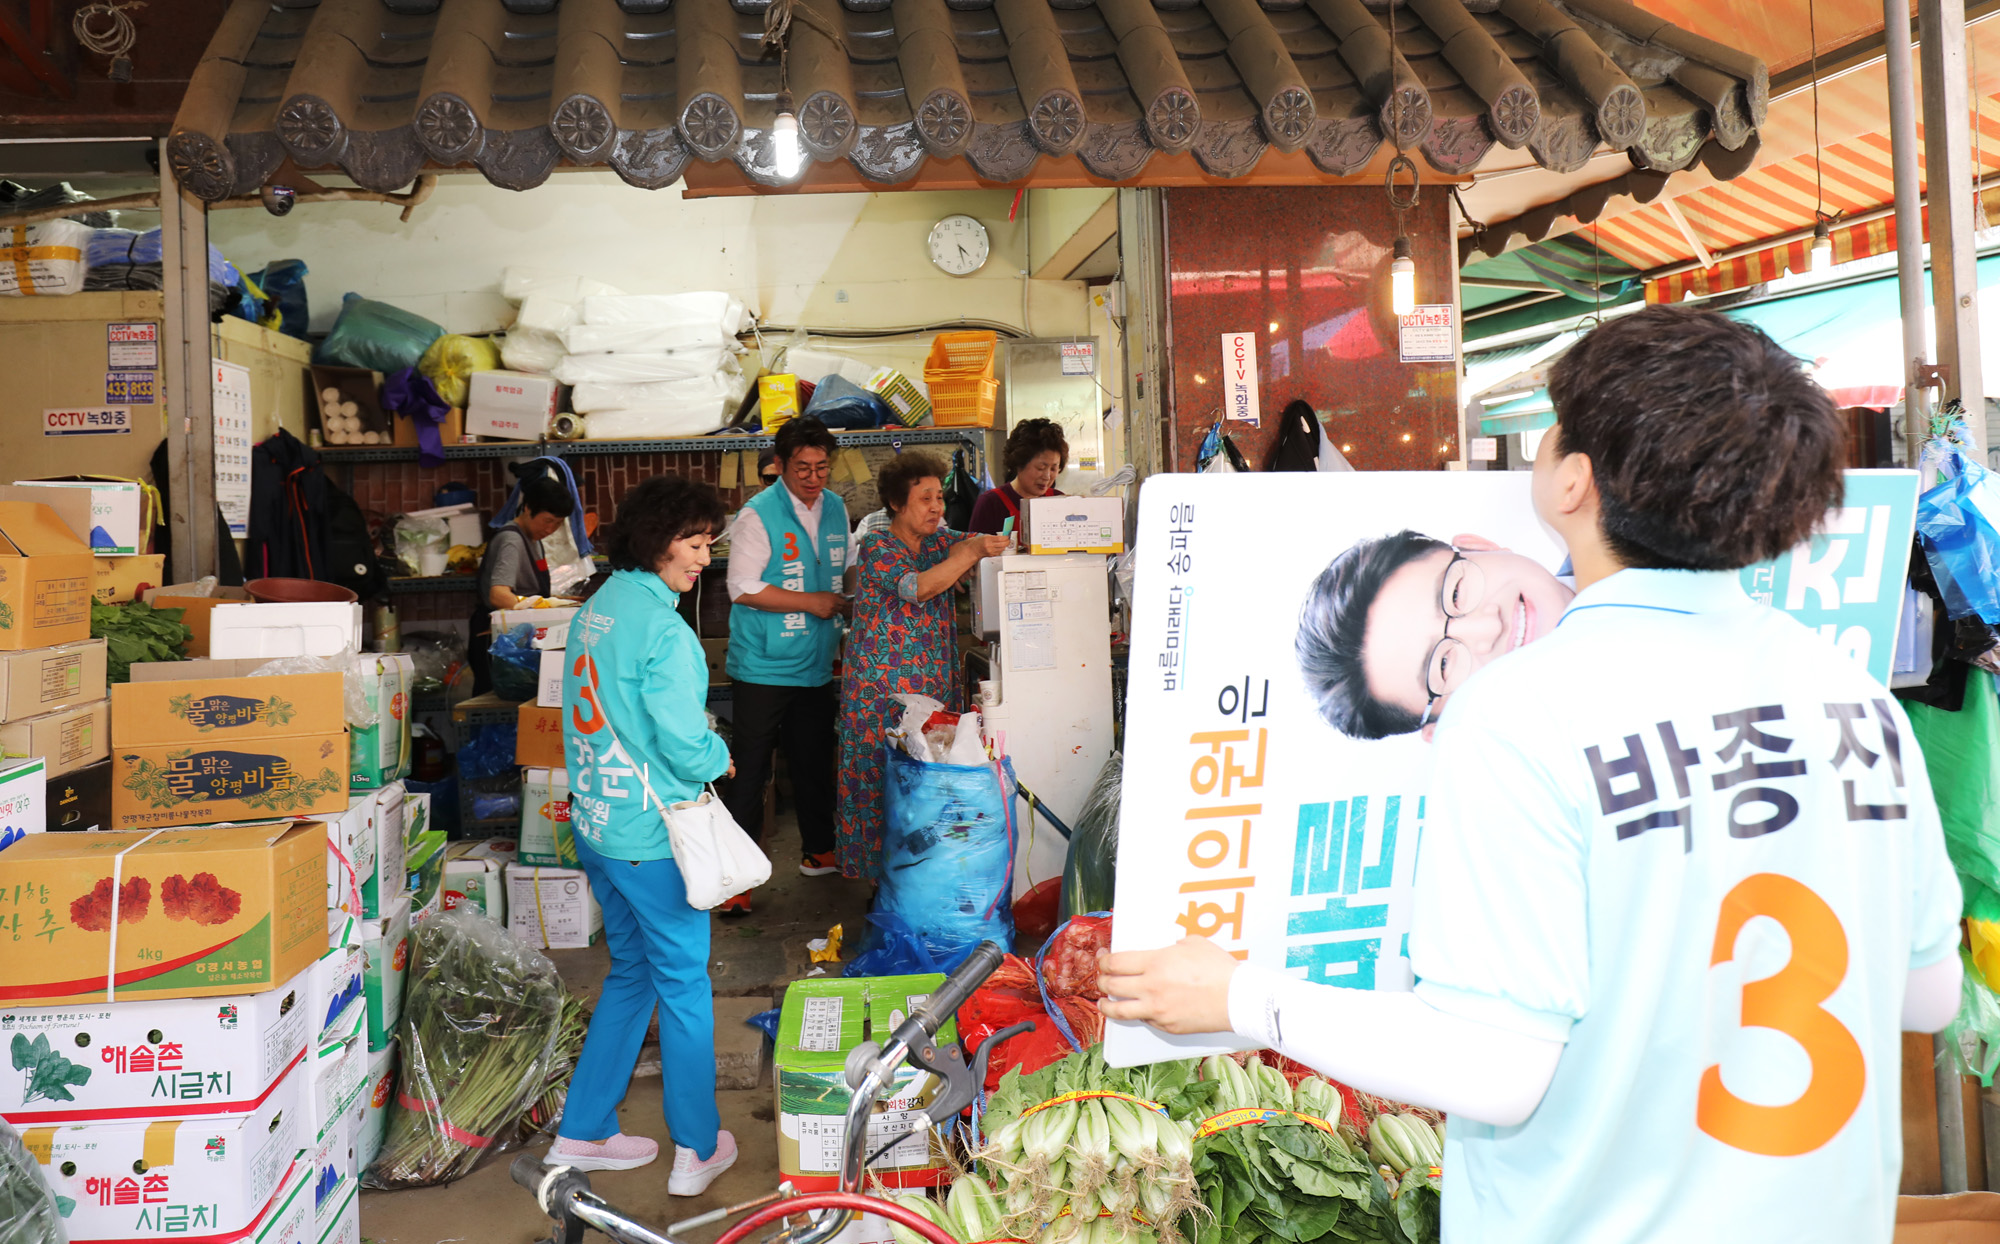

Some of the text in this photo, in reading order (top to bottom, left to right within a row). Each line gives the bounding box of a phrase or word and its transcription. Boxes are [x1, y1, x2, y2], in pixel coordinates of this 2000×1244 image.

[1402, 314, 1450, 326] CCTV녹화중
[110, 330, 155, 341] CCTV녹화중
[217, 368, 223, 382] 6
[1234, 336, 1248, 418] CCTV 녹화중
[48, 411, 126, 426] CCTV 녹화중
[782, 532, 800, 561] 3
[782, 561, 806, 630] 국회원
[1158, 502, 1196, 692] 바른미래당 송파을
[209, 699, 230, 711] 맑은
[573, 654, 605, 735] 3
[215, 702, 272, 725] 양평 비름
[162, 756, 233, 796] 물 맑은
[210, 761, 297, 796] 양평 비름
[1583, 698, 1909, 855] 박종진
[1175, 674, 1269, 962] 회의원은
[137, 947, 163, 961] 4kg
[208, 959, 263, 973] 경서농협
[1696, 872, 1867, 1158] 3
[101, 1042, 183, 1074] 해솔촌
[151, 1071, 231, 1100] 시금치
[86, 1174, 169, 1206] 해솔촌
[135, 1204, 218, 1233] 시금치
